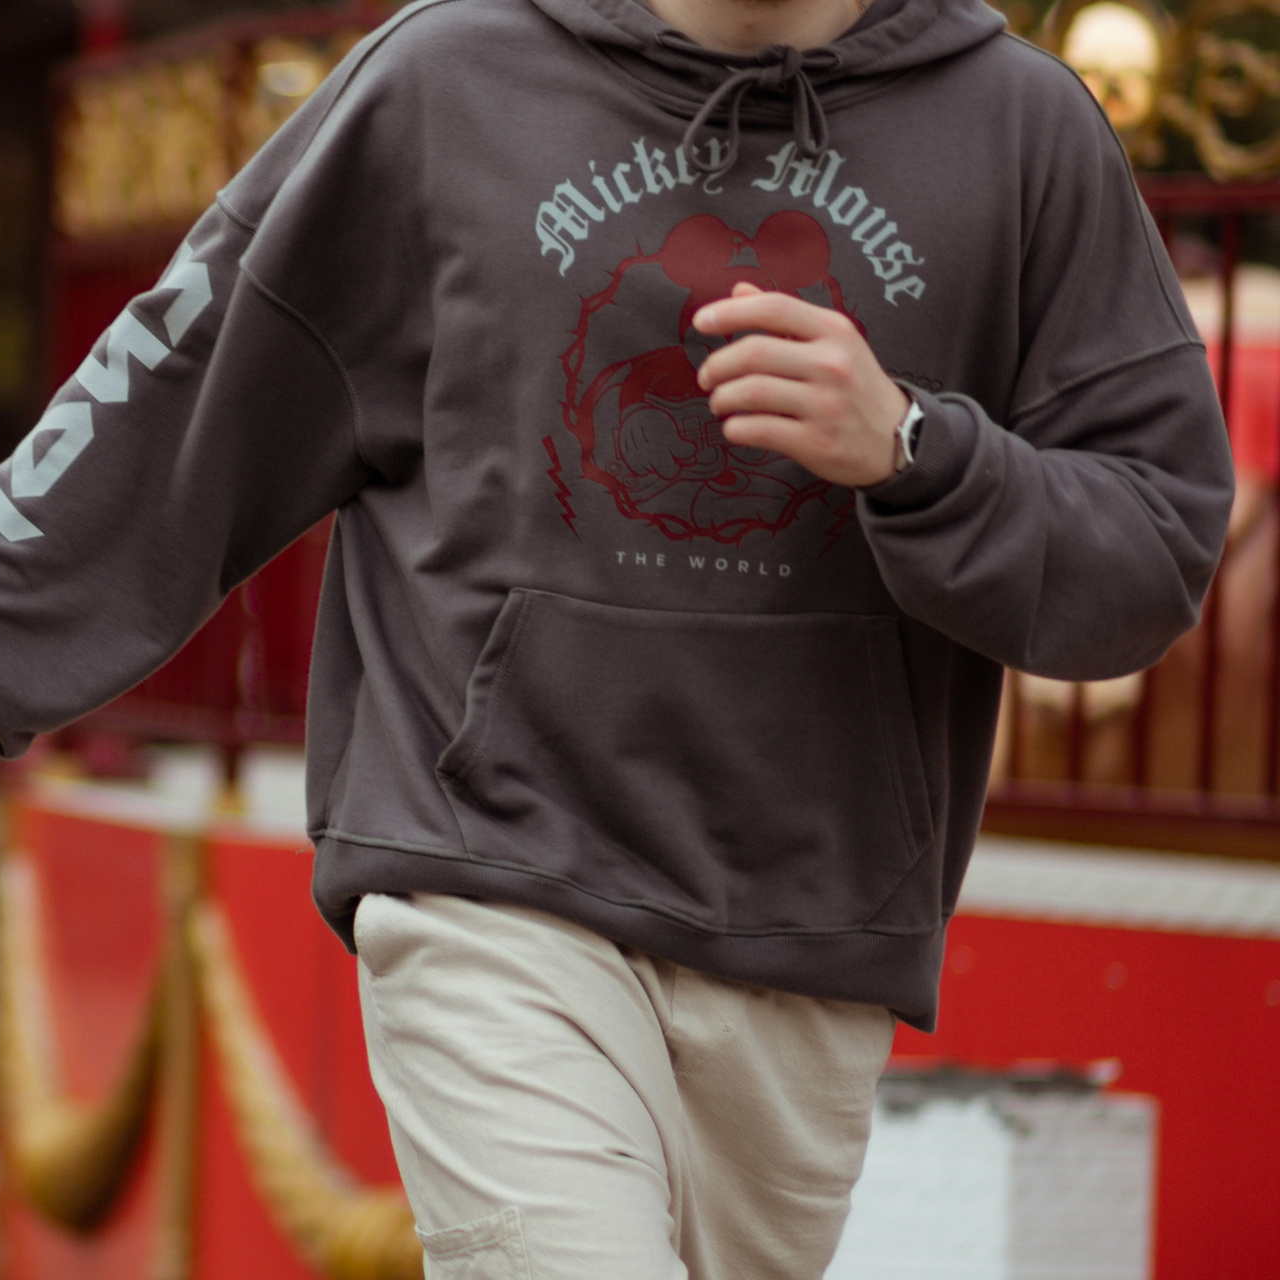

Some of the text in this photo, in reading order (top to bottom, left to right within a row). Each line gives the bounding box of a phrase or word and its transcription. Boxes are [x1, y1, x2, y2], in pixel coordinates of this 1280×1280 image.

[750, 140, 926, 307] Mouse
[616, 550, 792, 577] THE WORLD
